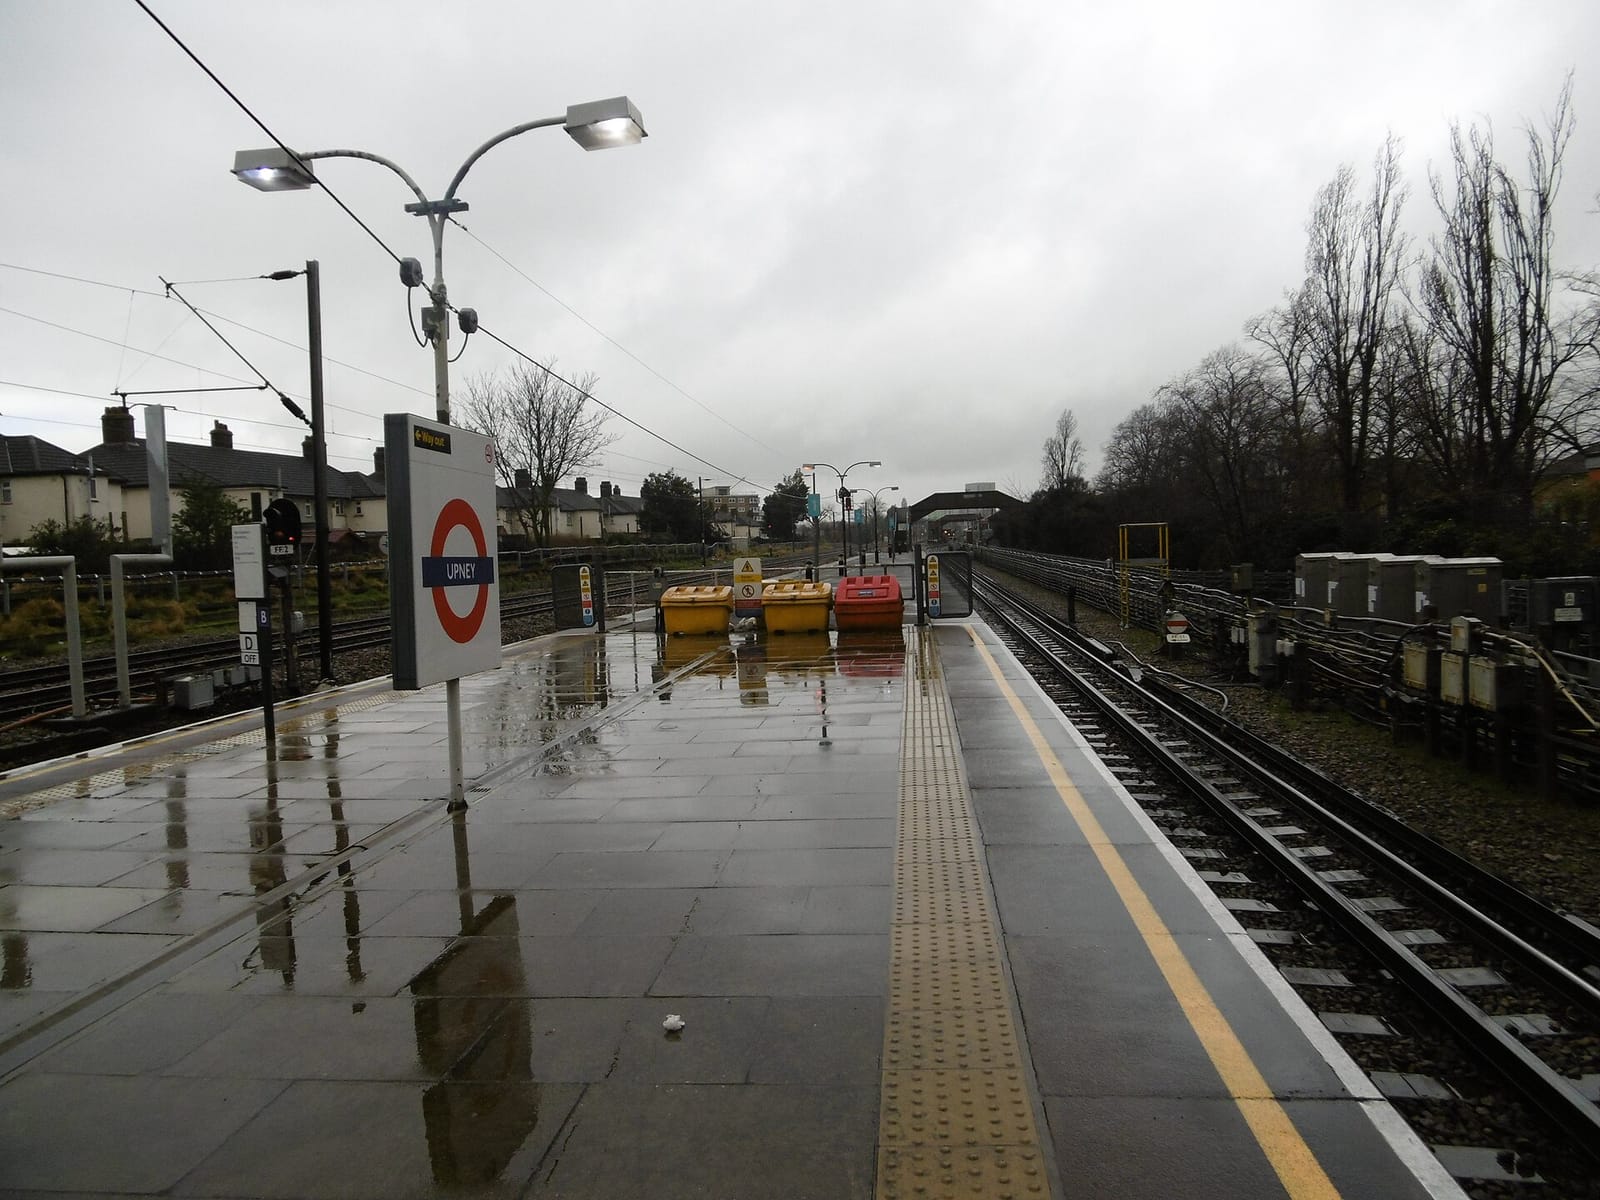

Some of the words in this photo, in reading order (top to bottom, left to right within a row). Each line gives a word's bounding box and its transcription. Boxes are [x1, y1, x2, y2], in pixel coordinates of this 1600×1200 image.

[421, 431, 434, 447] Way
[434, 436, 445, 447] out
[446, 563, 476, 580] UPNEY
[260, 611, 267, 624] B
[245, 637, 253, 650] D
[244, 654, 257, 663] OFF
